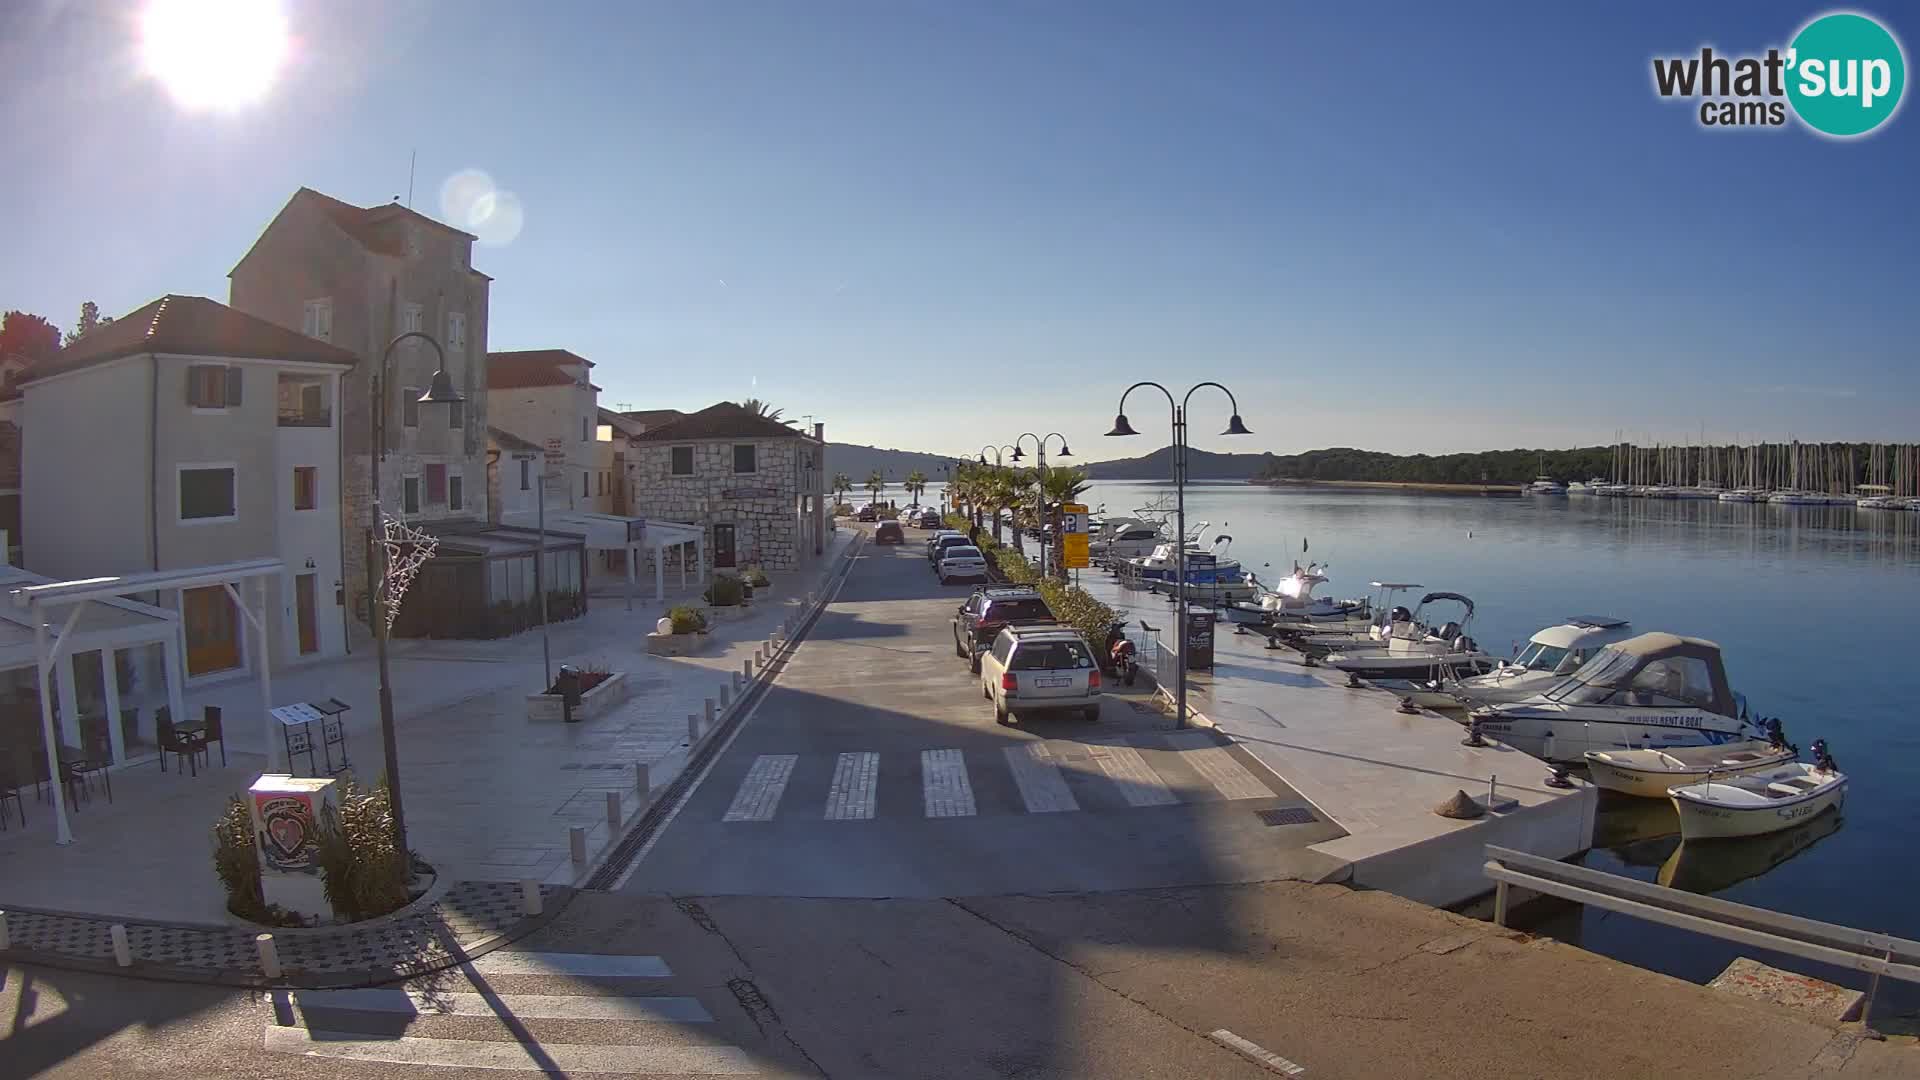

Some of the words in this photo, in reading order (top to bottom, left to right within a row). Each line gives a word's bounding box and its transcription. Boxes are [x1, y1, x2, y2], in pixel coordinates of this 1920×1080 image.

[1065, 515, 1076, 531] P
[1660, 716, 1679, 726] RENT
[1685, 716, 1703, 728] BOAT
